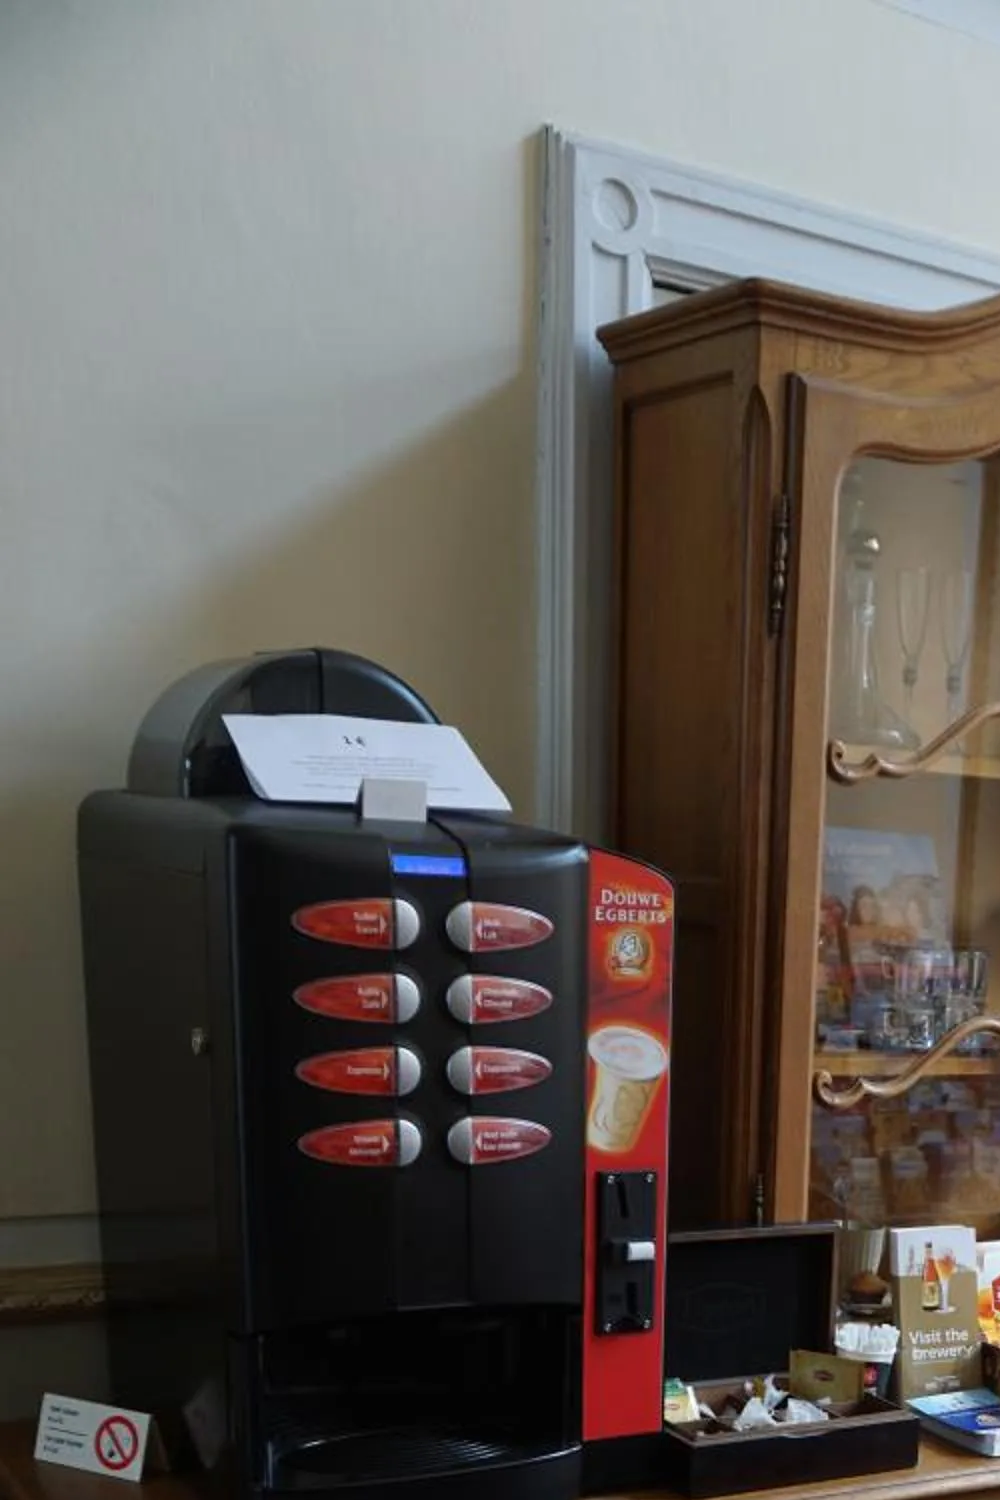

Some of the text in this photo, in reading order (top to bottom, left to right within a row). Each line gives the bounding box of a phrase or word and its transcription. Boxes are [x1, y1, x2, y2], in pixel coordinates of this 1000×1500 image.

[601, 888, 662, 907] DOUWE
[595, 905, 667, 925] EGBERTS
[908, 1327, 969, 1345] Visit the
[912, 1344, 974, 1362] brewery
